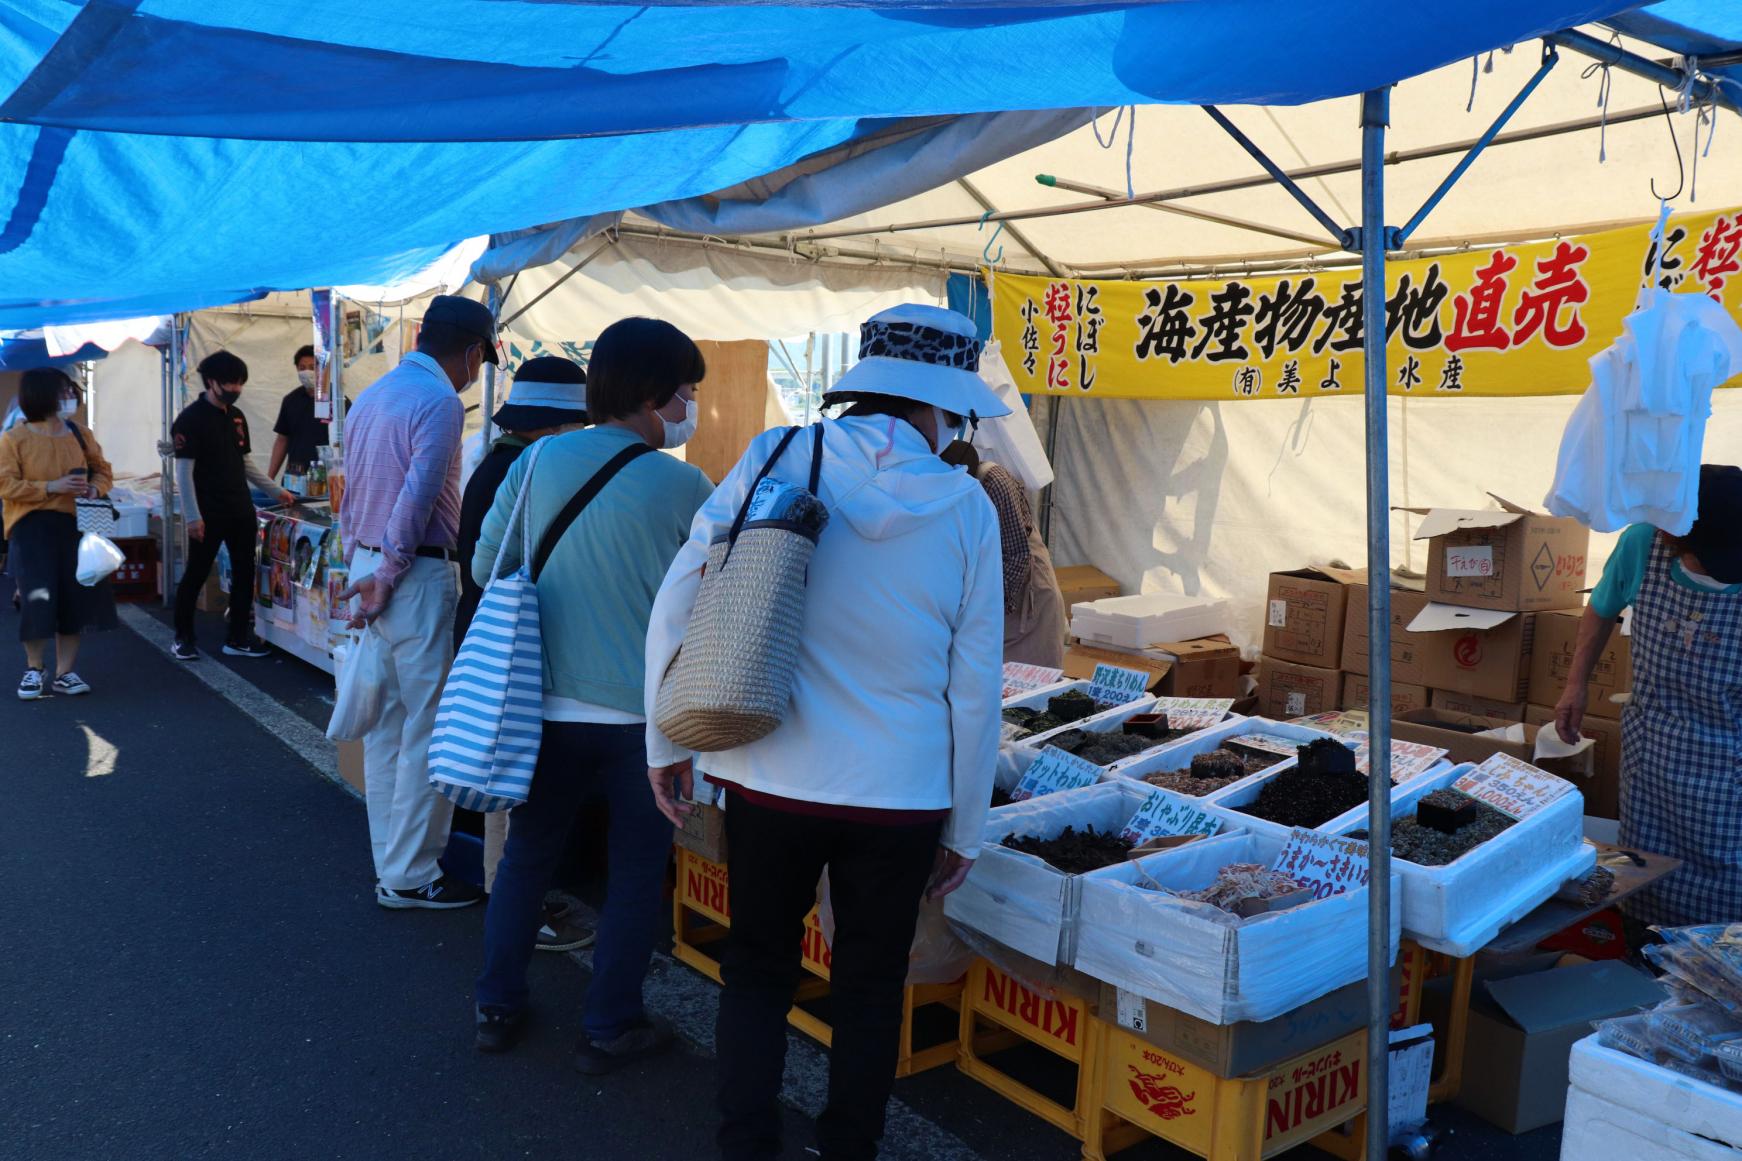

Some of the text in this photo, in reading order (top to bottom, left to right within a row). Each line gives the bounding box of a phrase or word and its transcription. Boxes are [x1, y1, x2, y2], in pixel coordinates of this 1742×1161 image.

[1021, 299, 1039, 375] 小佐々
[1046, 282, 1073, 389] 粒うに
[1077, 284, 1104, 390] にぼし
[1136, 241, 1588, 362] 海産物産地直売
[985, 967, 1078, 1046] KIRIN
[1266, 1059, 1360, 1140] KIRIN
[1292, 1050, 1342, 1081] キリンビール
